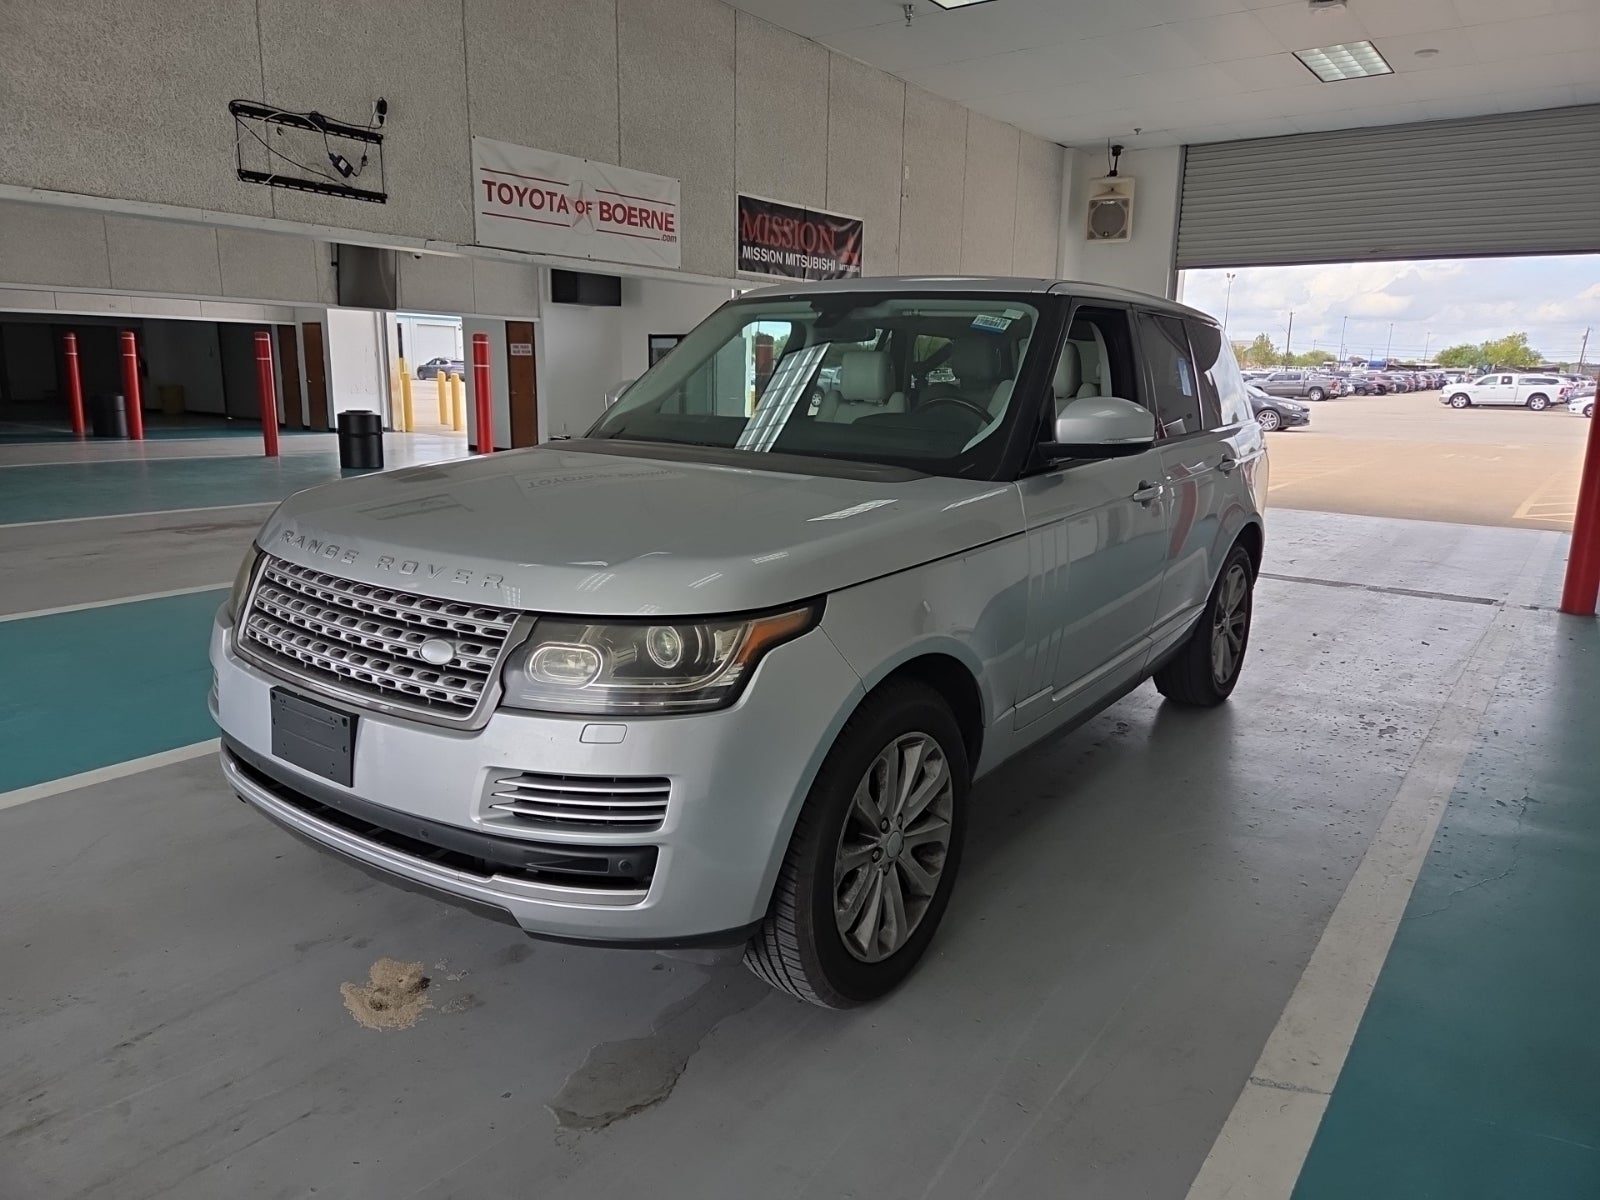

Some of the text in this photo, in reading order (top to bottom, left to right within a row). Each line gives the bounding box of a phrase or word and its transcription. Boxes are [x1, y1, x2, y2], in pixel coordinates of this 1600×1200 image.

[482, 180, 675, 233] TOYOTA OF BOERNE
[661, 234, 677, 243] .com
[742, 208, 837, 256] MISSION
[742, 245, 836, 272] MISSION MITSUBISHI
[279, 530, 504, 589] RANGE ROVER
